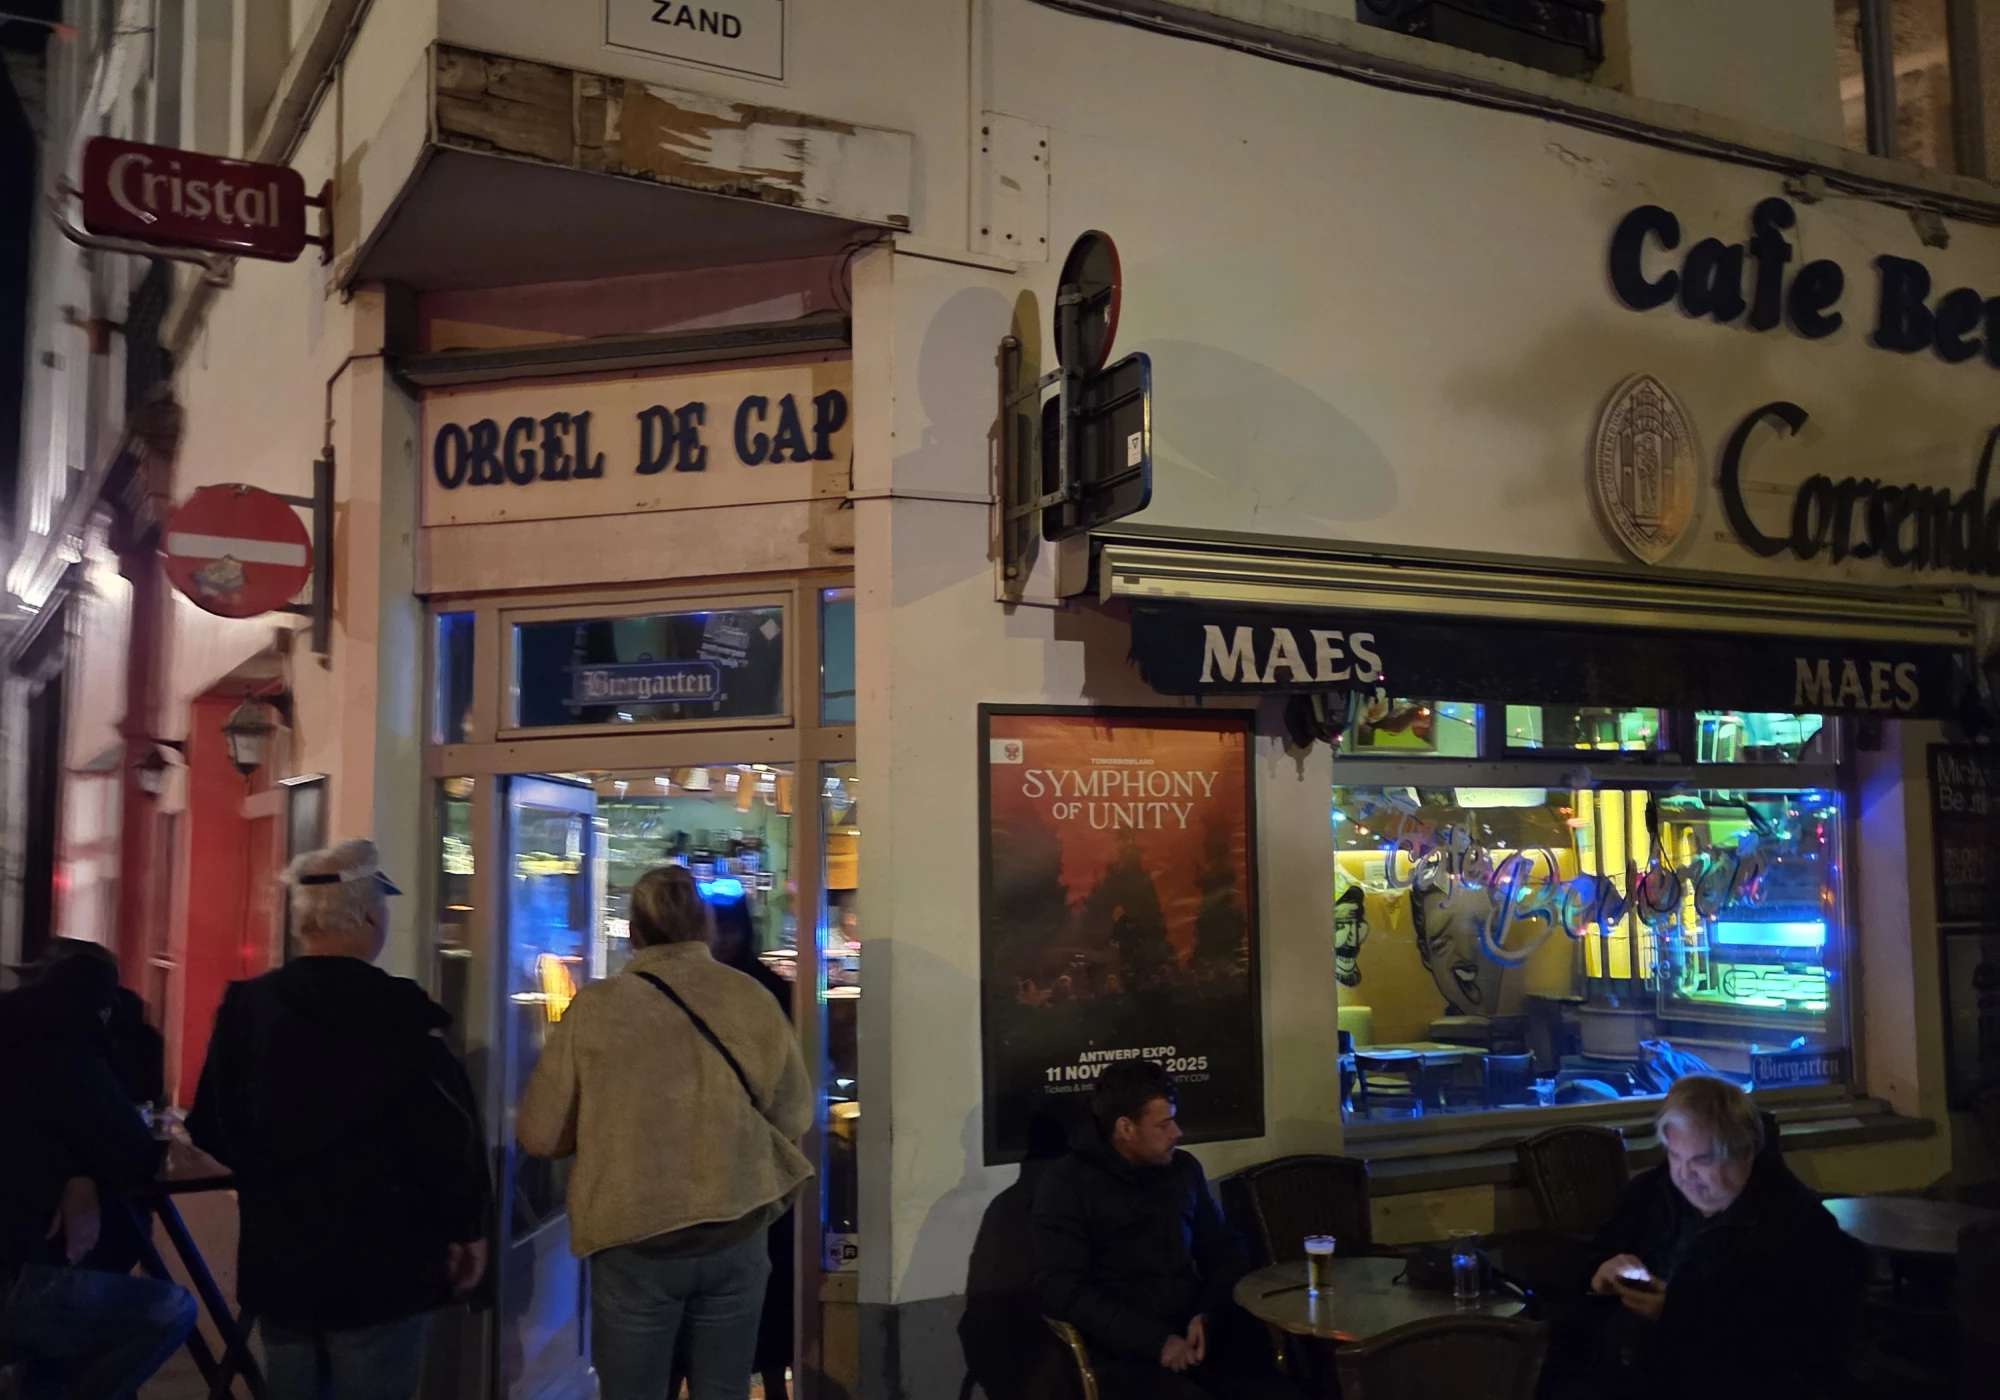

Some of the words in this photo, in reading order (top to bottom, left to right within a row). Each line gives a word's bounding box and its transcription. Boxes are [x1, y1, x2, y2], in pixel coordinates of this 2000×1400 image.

[651, 0, 742, 39] ZAND
[107, 152, 281, 228] Cristal
[1610, 196, 1844, 339] Cafe
[434, 409, 604, 490] ORGEL
[635, 401, 707, 475] DE
[733, 389, 848, 467] CAP
[1199, 624, 1383, 683] MAES
[582, 669, 713, 700] Biergarten
[1794, 657, 1920, 712] MAES
[1090, 758, 1155, 766] TOMORROWLAND
[1022, 769, 1219, 798] SYMPHONY
[1052, 803, 1082, 820] OF
[1088, 803, 1194, 830] UNITY
[1045, 1066, 1061, 1082] 11
[1165, 1056, 1209, 1073] 2025
[1078, 1047, 1140, 1063] ANTWERP
[1142, 1046, 1177, 1059] EXPO
[1758, 1055, 1840, 1082] Biergarten
